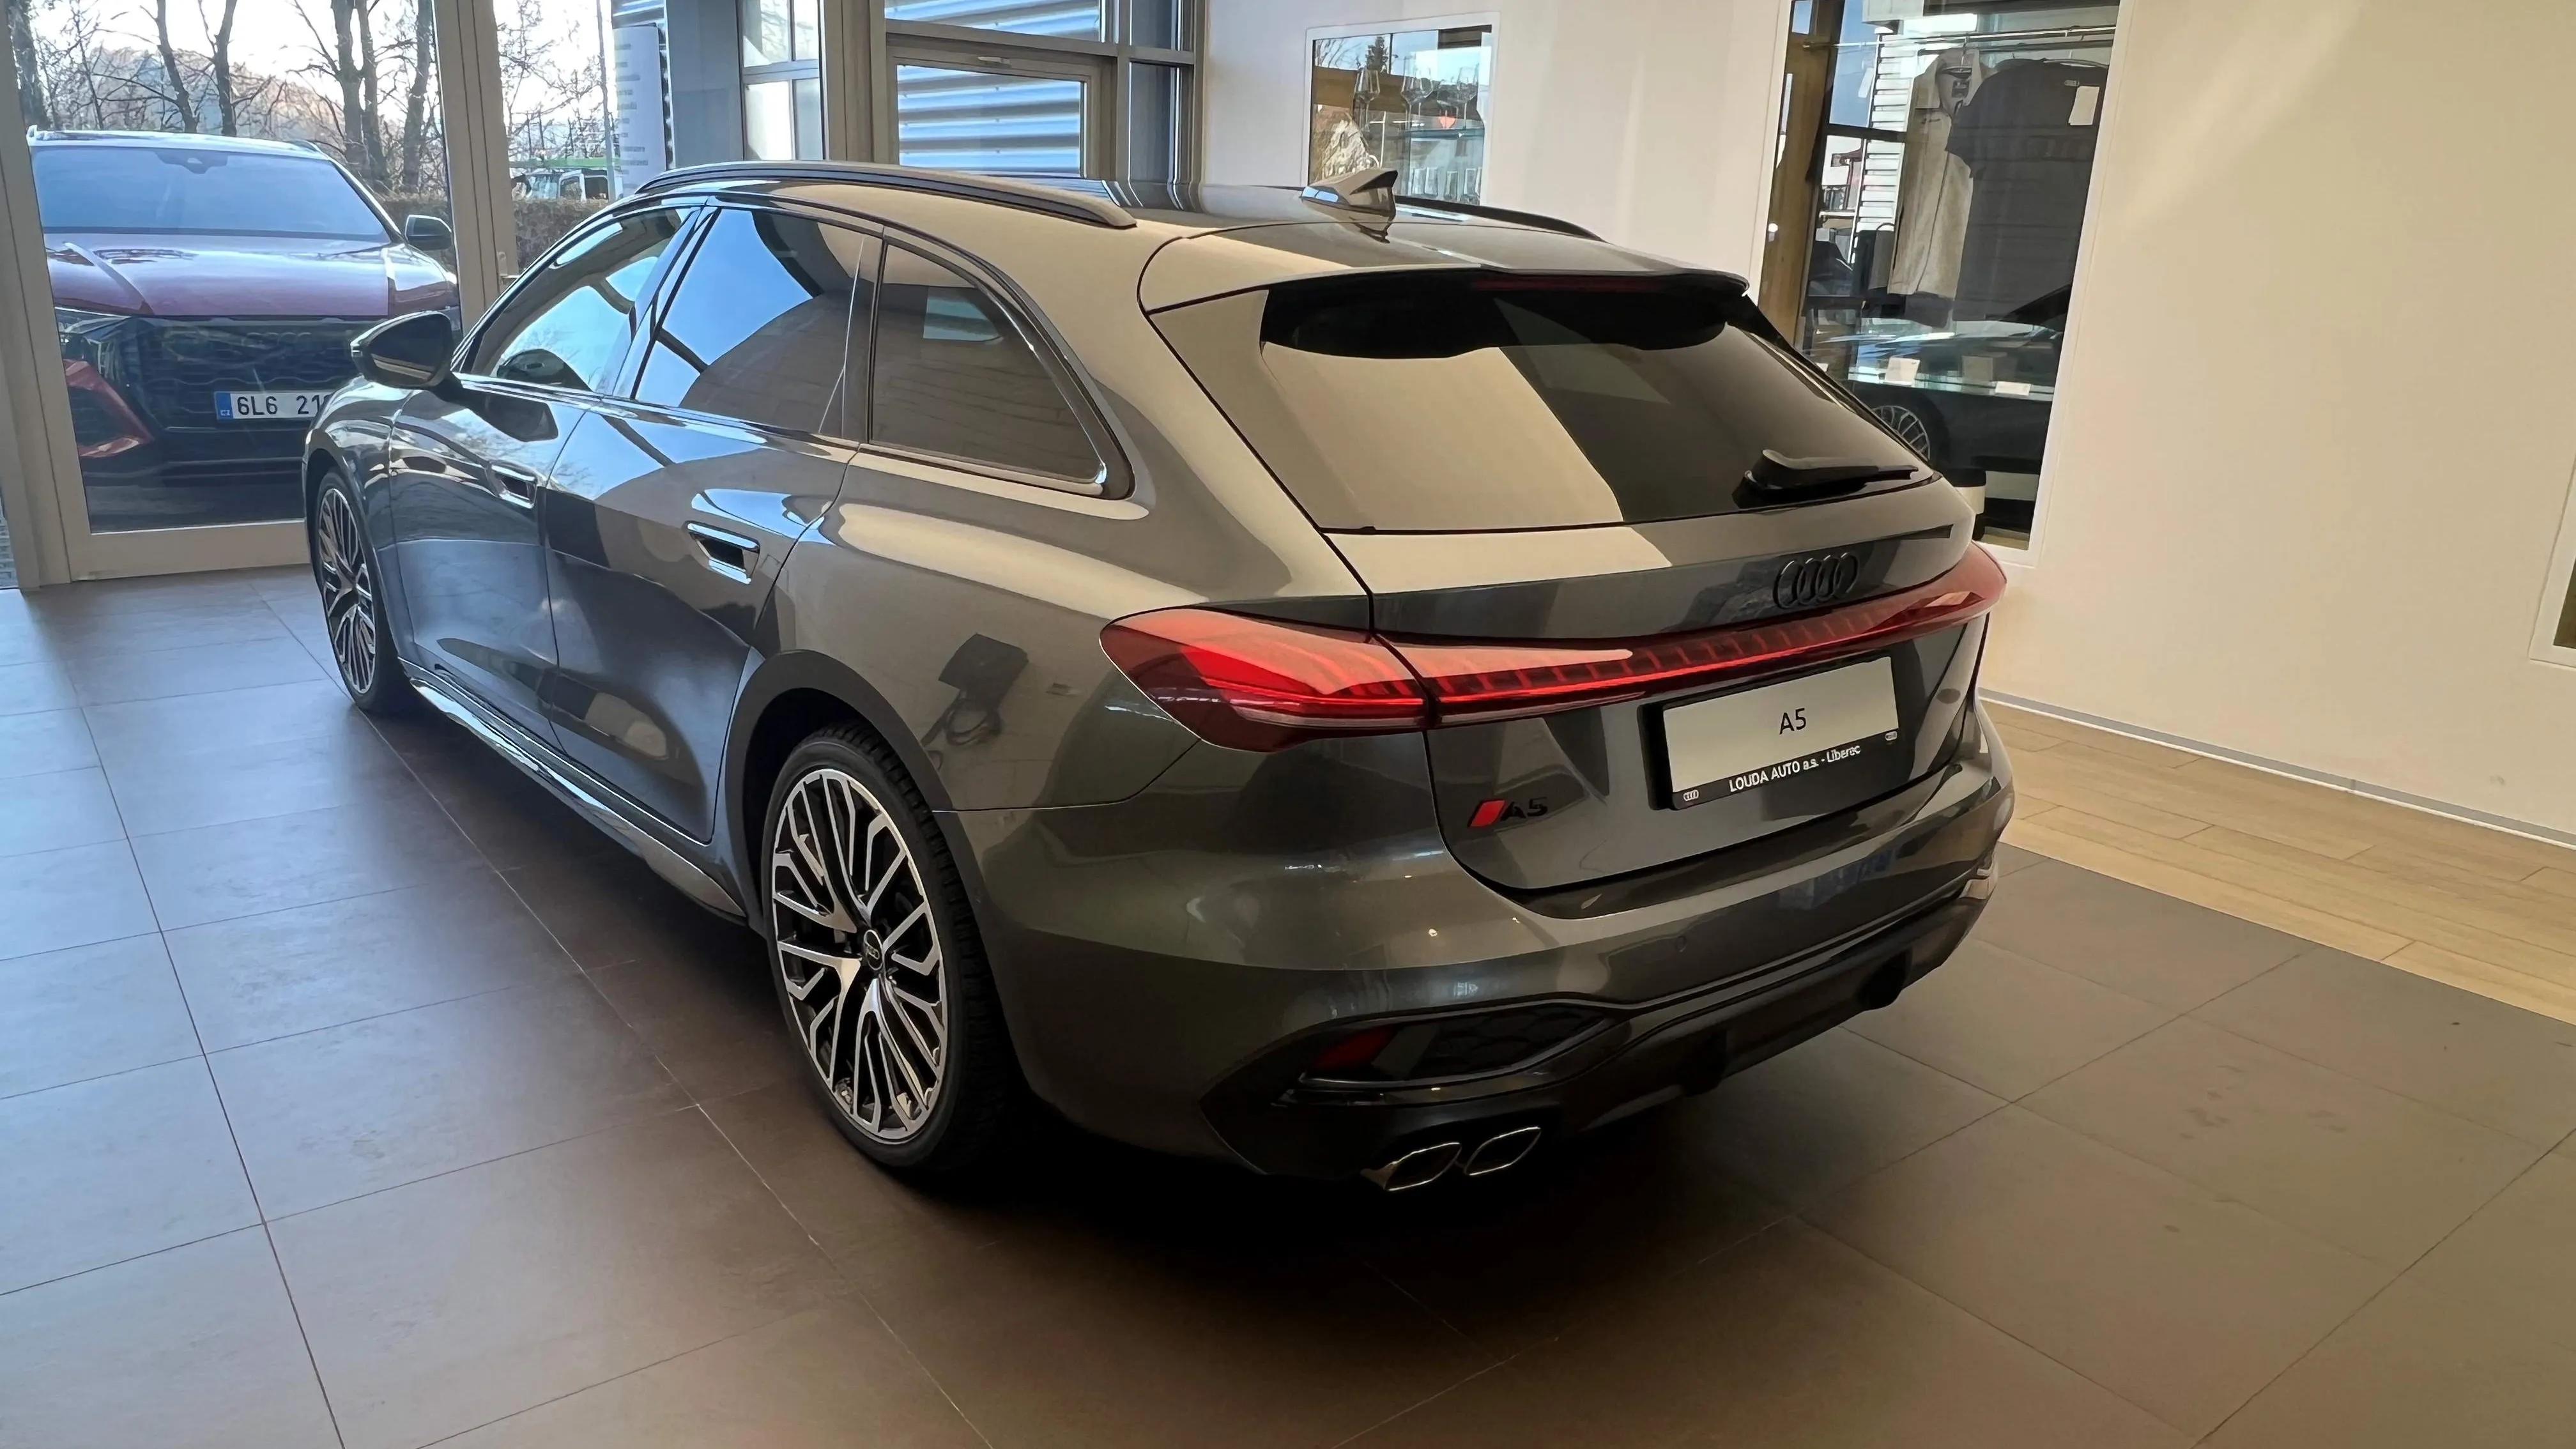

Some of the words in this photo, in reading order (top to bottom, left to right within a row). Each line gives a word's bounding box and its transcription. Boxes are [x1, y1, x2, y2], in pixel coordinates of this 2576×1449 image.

[237, 395, 278, 416] 6L6
[1779, 707, 1807, 735] A5
[1729, 770, 1768, 792] LOUDA
[1771, 761, 1800, 780] AUTO
[1826, 745, 1861, 763] Liberec
[1499, 797, 1548, 822] A5
